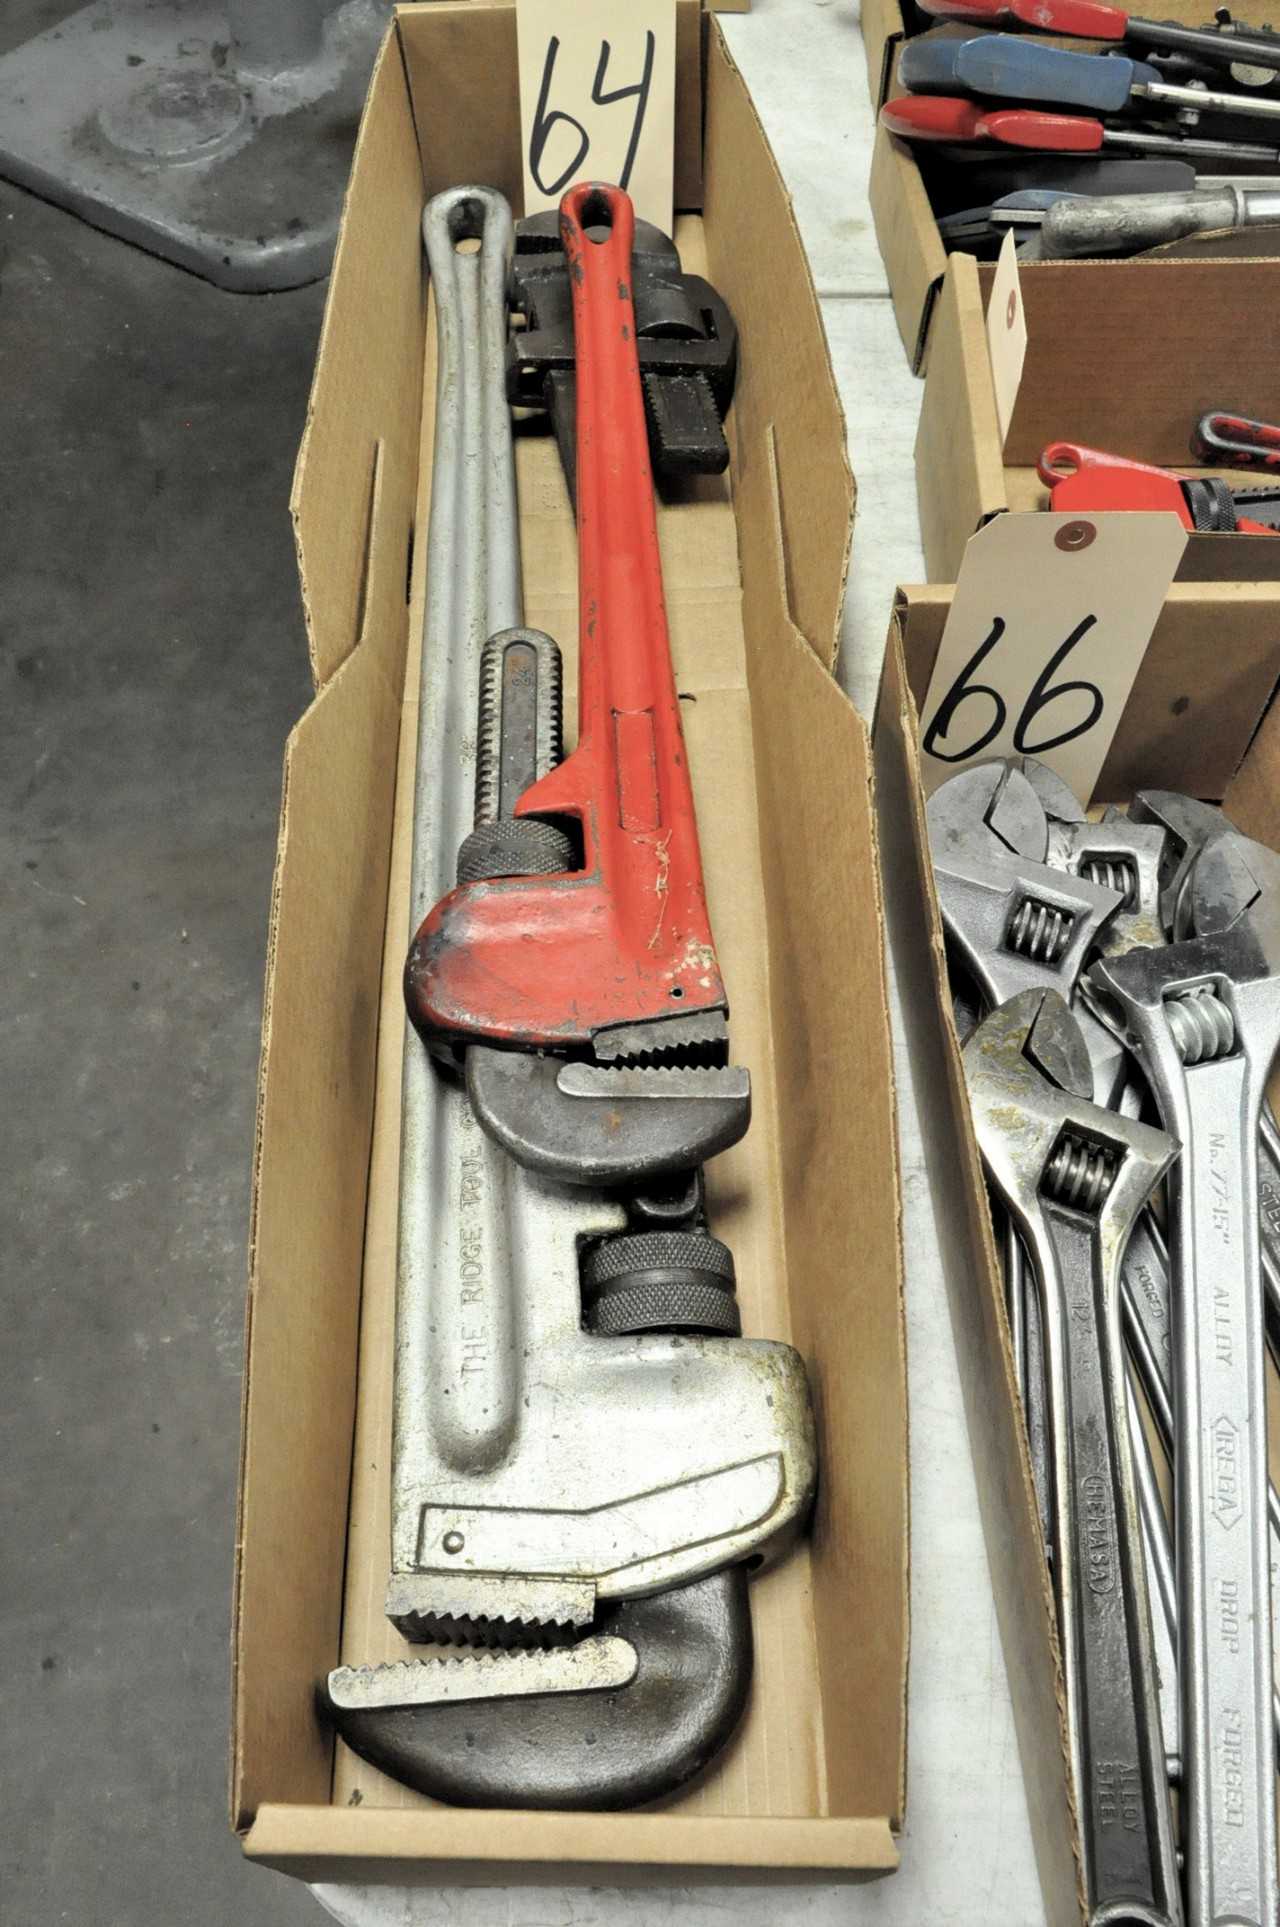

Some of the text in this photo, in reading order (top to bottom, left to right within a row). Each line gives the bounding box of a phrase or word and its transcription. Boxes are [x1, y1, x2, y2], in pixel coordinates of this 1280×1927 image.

[530, 30, 655, 196] 64
[922, 614, 1104, 763] 66
[460, 1228, 484, 1306] RIDGE
[1134, 1264, 1165, 1320] FORGED
[461, 1325, 487, 1378] THE
[1213, 1286, 1232, 1367] ALLOY
[1220, 1580, 1239, 1654] DROP
[1119, 1762, 1140, 1832] ALLOY
[1222, 1707, 1244, 1828] FORGED
